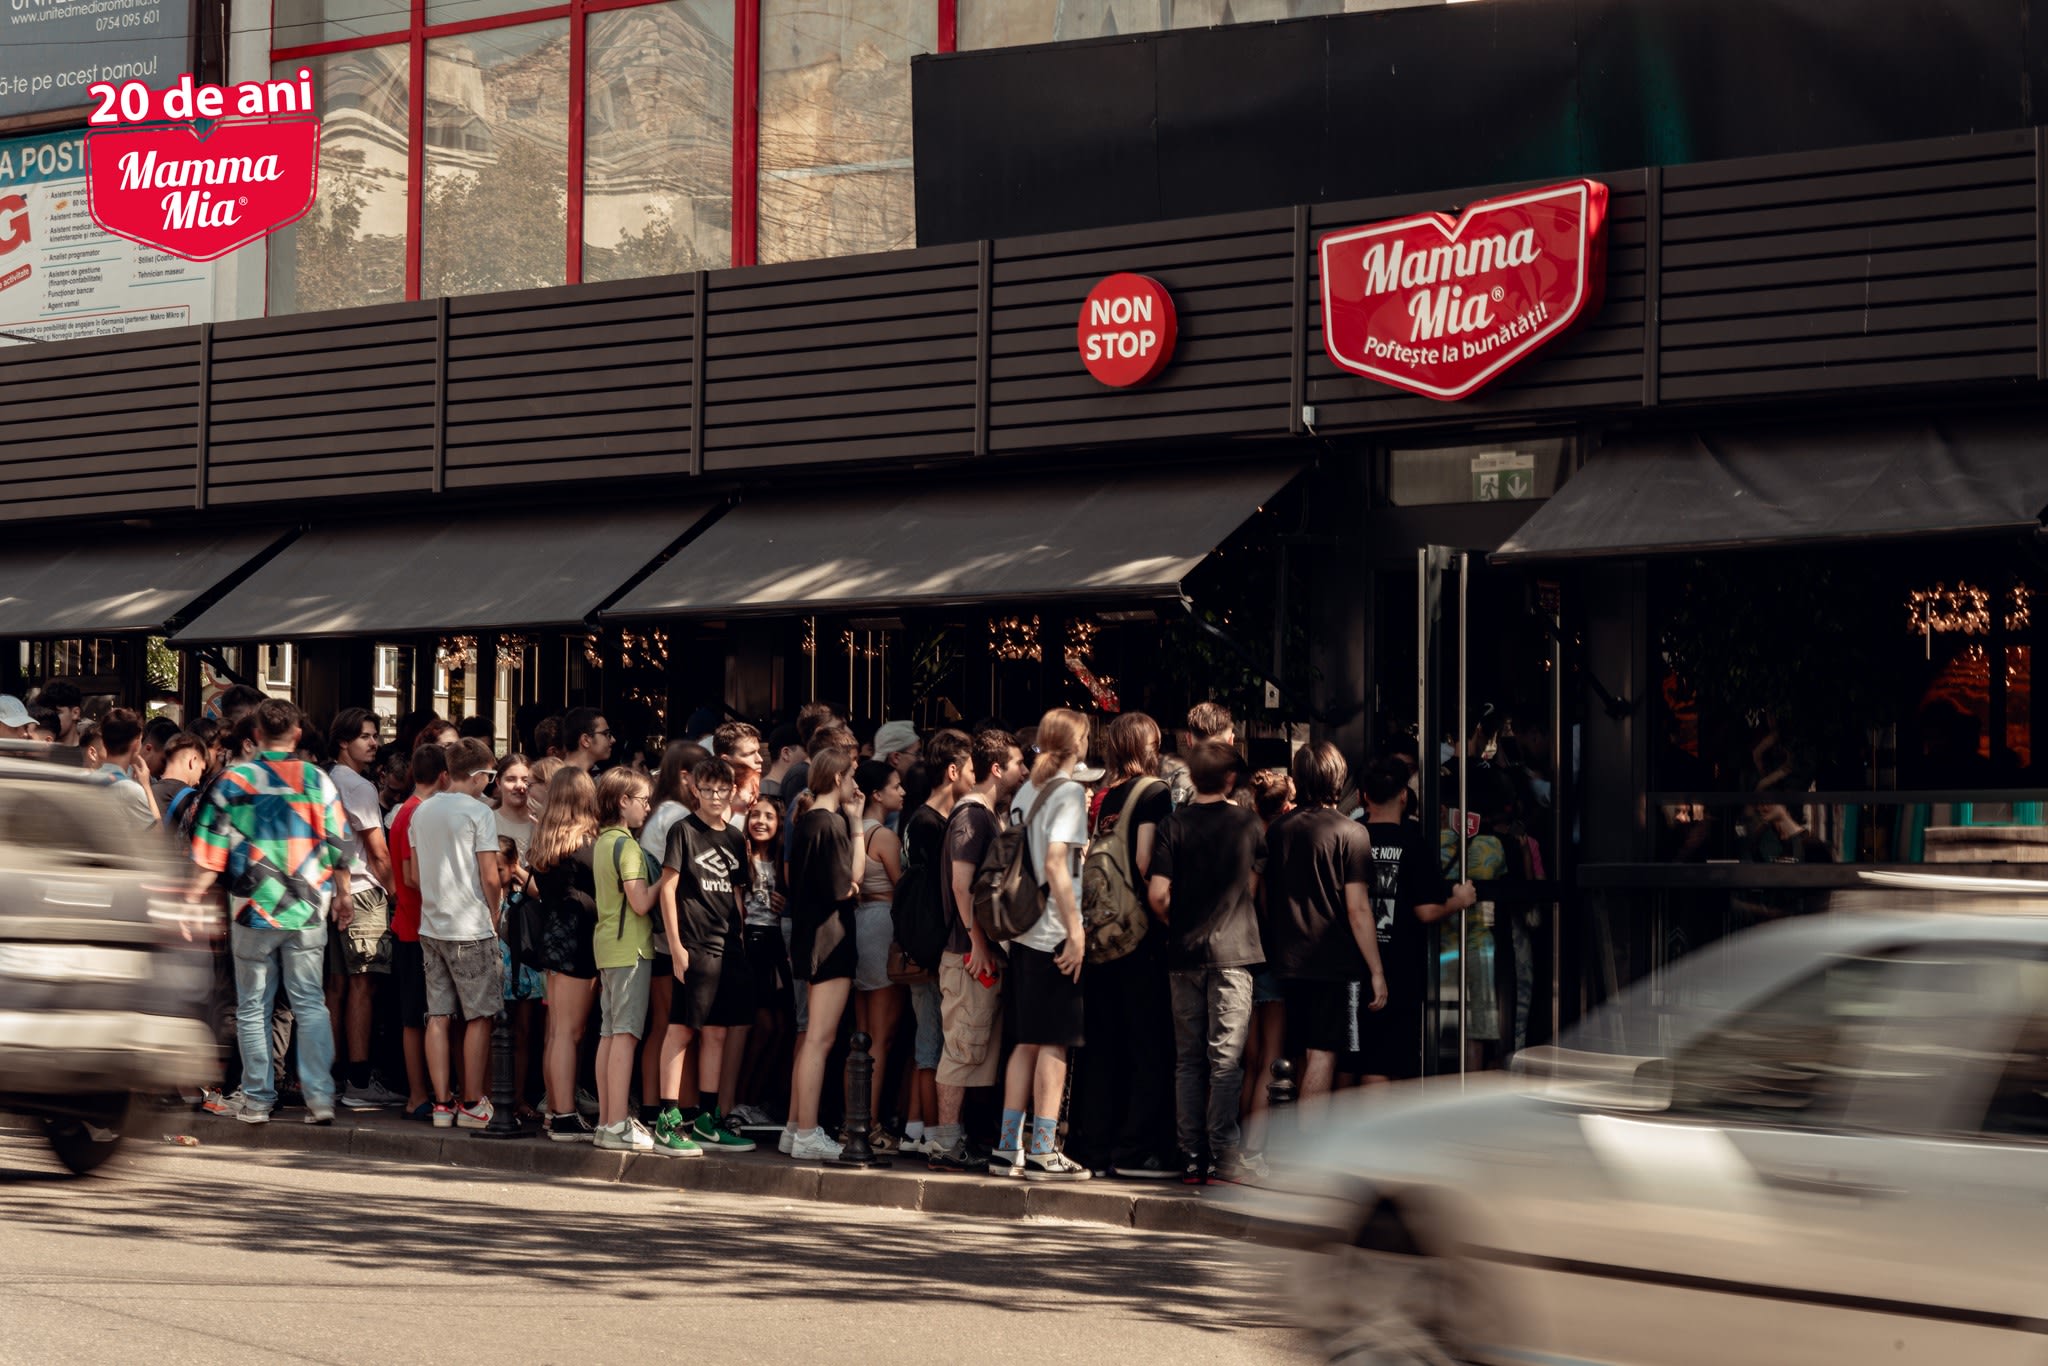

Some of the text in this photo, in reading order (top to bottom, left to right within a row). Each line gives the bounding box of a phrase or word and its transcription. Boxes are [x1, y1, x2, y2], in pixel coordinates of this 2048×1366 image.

[96, 10, 160, 31] 0754 095 601
[32, 74, 52, 95] pe
[56, 64, 98, 88] acest
[102, 55, 158, 82] panou!
[1363, 228, 1541, 296] Mamma
[1091, 295, 1152, 326] NON
[1087, 329, 1156, 361] STOP
[1364, 301, 1548, 368] Poftește la bunătăți!
[1380, 847, 1403, 860] NOW
